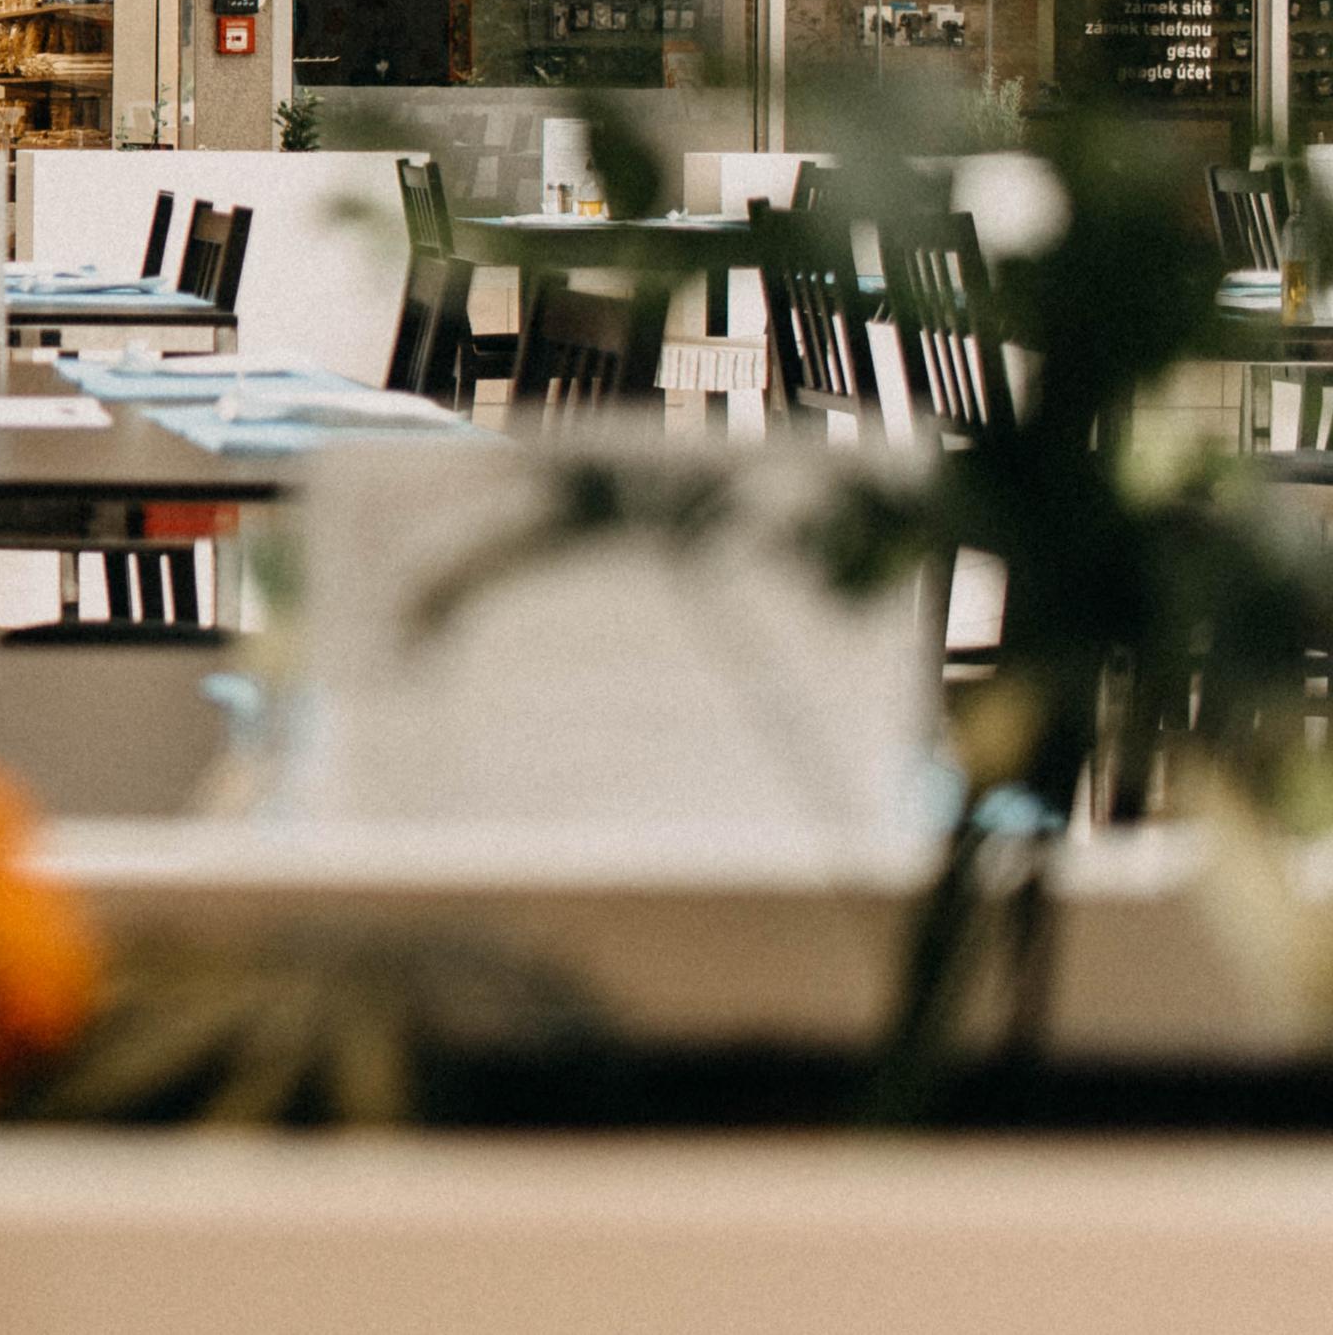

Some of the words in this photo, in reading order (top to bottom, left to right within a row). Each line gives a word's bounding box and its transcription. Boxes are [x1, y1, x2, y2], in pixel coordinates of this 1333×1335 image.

[1182, 0, 1212, 16] sítě
[1143, 20, 1212, 37] telefonu
[1166, 42, 1212, 61] gesto
[1176, 63, 1212, 81] účet
